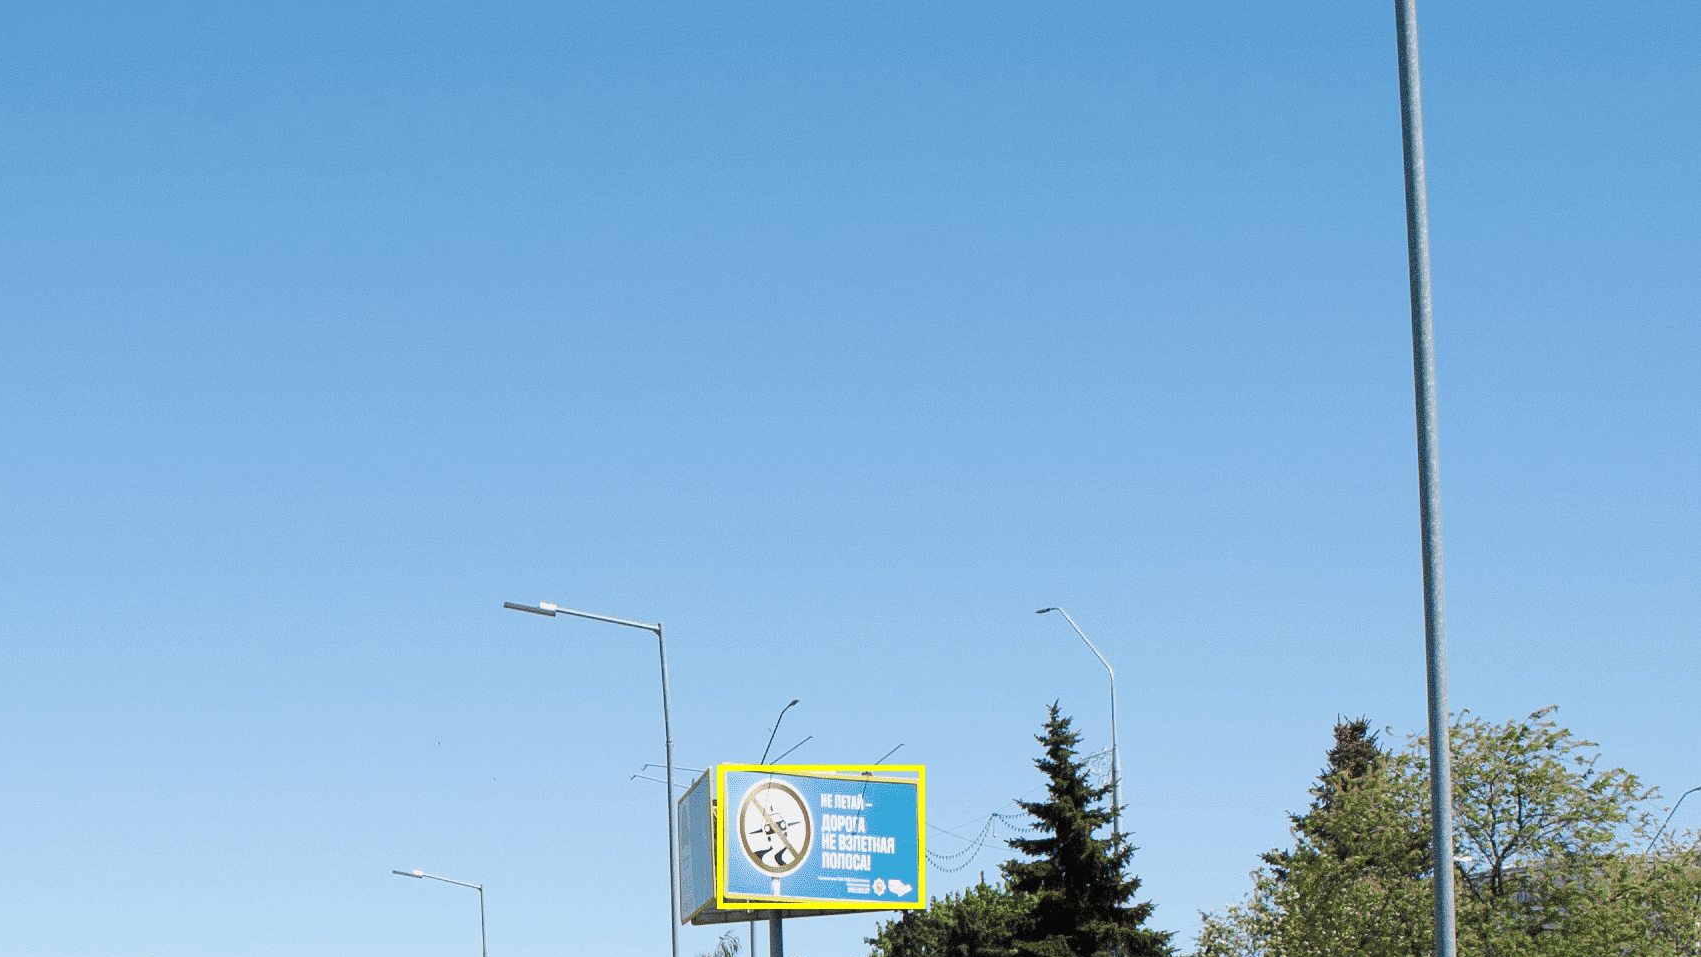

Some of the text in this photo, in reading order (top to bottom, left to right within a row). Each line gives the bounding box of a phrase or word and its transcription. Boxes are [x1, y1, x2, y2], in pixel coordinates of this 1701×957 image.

[820, 793, 833, 808] НЕ
[834, 793, 864, 810] ЛЕТАЙ
[821, 814, 866, 833] ДОРОГА
[821, 833, 895, 854] НЕ ВЗЛЕТНАЯ
[821, 851, 871, 871] ПОЛОСА!
